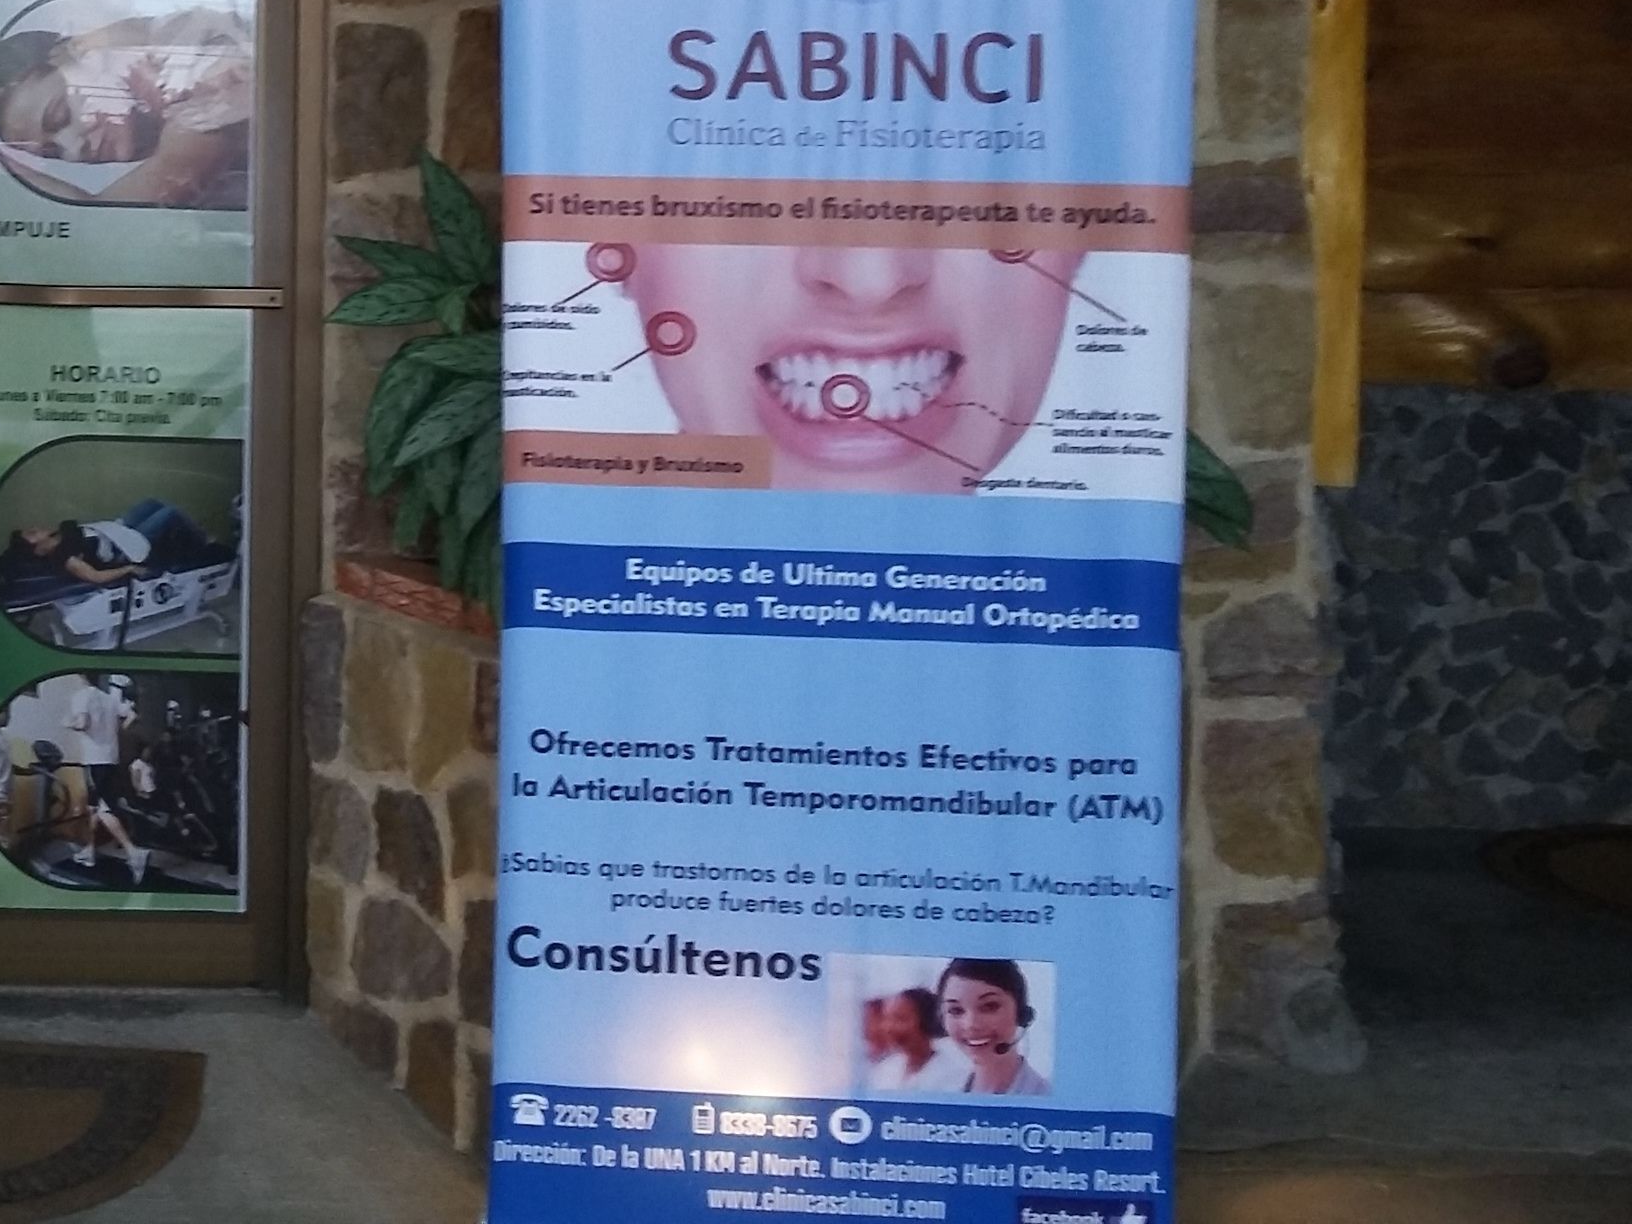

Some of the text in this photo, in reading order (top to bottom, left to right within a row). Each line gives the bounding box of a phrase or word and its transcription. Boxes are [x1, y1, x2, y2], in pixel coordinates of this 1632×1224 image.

[668, 30, 1045, 104] SABINCI
[794, 124, 826, 148] de
[835, 120, 1046, 154] Fisioterapia
[530, 193, 1157, 228] Si tienes bruxismo el fisioterapeuta te ayuda.
[51, 365, 161, 384] HORARIO
[522, 452, 633, 471] Fisioterapia
[653, 456, 744, 474] Bruxismo
[625, 557, 1046, 594] Equipos de Ultima Generación
[533, 589, 1139, 634] Especialistas en Terapia Manual Ortopédica
[530, 728, 1137, 780] Ofrecemos Tratamientos Efectivos para
[513, 774, 1164, 826] la Articulación Temporomandibular (ATM)
[599, 859, 645, 882] que
[652, 860, 776, 885] trastornos
[785, 864, 816, 884] de
[823, 864, 847, 887] la
[853, 866, 1001, 893] articulación
[610, 888, 1055, 926] produce fuertes dolores de cabeza?
[507, 926, 821, 981] Consúltenos
[553, 1103, 600, 1128] 2262
[880, 1116, 1153, 1155] clinicasabinci@gmail.com
[592, 1143, 616, 1167] De
[621, 1143, 639, 1169] la
[644, 1146, 684, 1172] UNA
[705, 1150, 735, 1174] KM
[739, 1150, 758, 1175] al
[830, 1156, 958, 1185] Instalaciones
[962, 1162, 1014, 1187] Hotel
[1019, 1165, 1088, 1191] Cibeles
[707, 1186, 946, 1220] www.clinicasabinci.com
